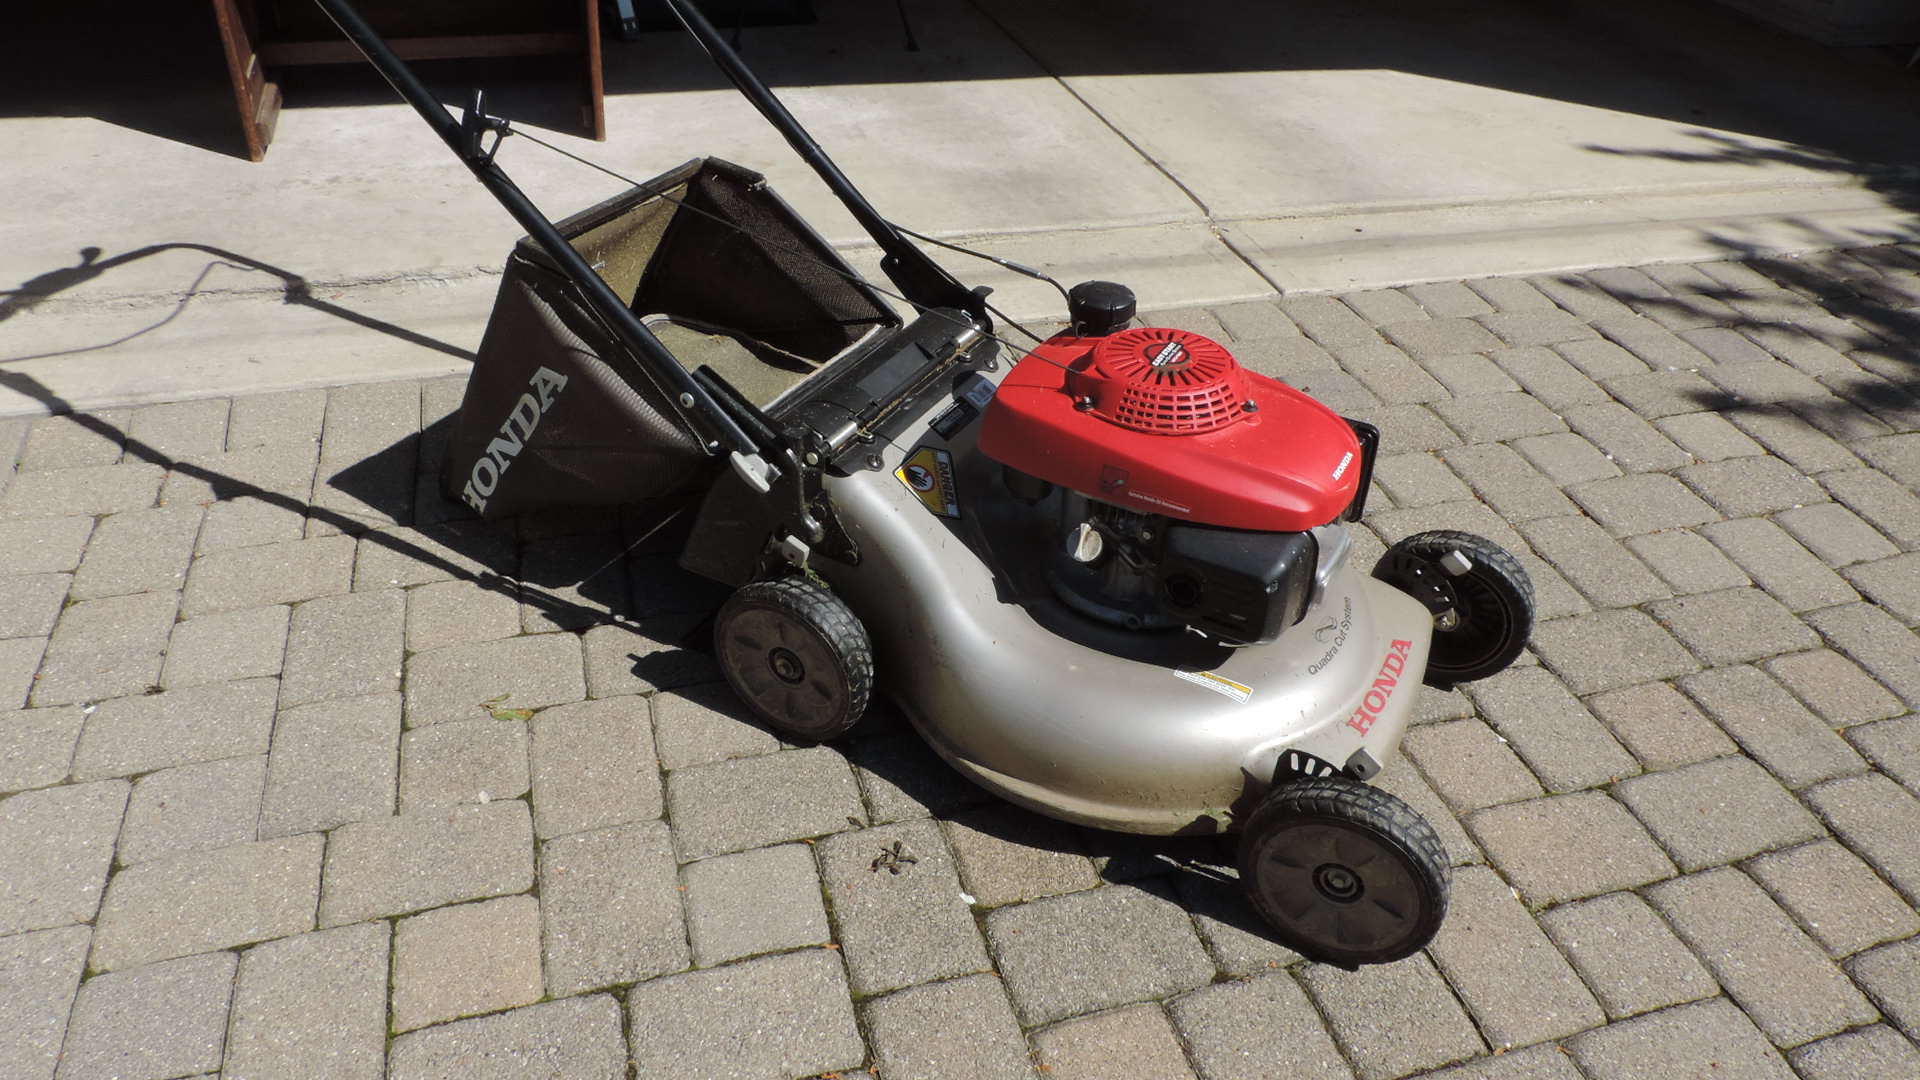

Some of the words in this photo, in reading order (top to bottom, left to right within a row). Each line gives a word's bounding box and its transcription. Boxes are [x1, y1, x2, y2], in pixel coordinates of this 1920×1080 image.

[938, 461, 956, 506] DANGER
[1331, 451, 1354, 481] HONDA
[1308, 646, 1339, 675] Quadra
[1334, 629, 1348, 647] Cut
[1341, 596, 1353, 631] System
[1345, 639, 1413, 737] HONDA
